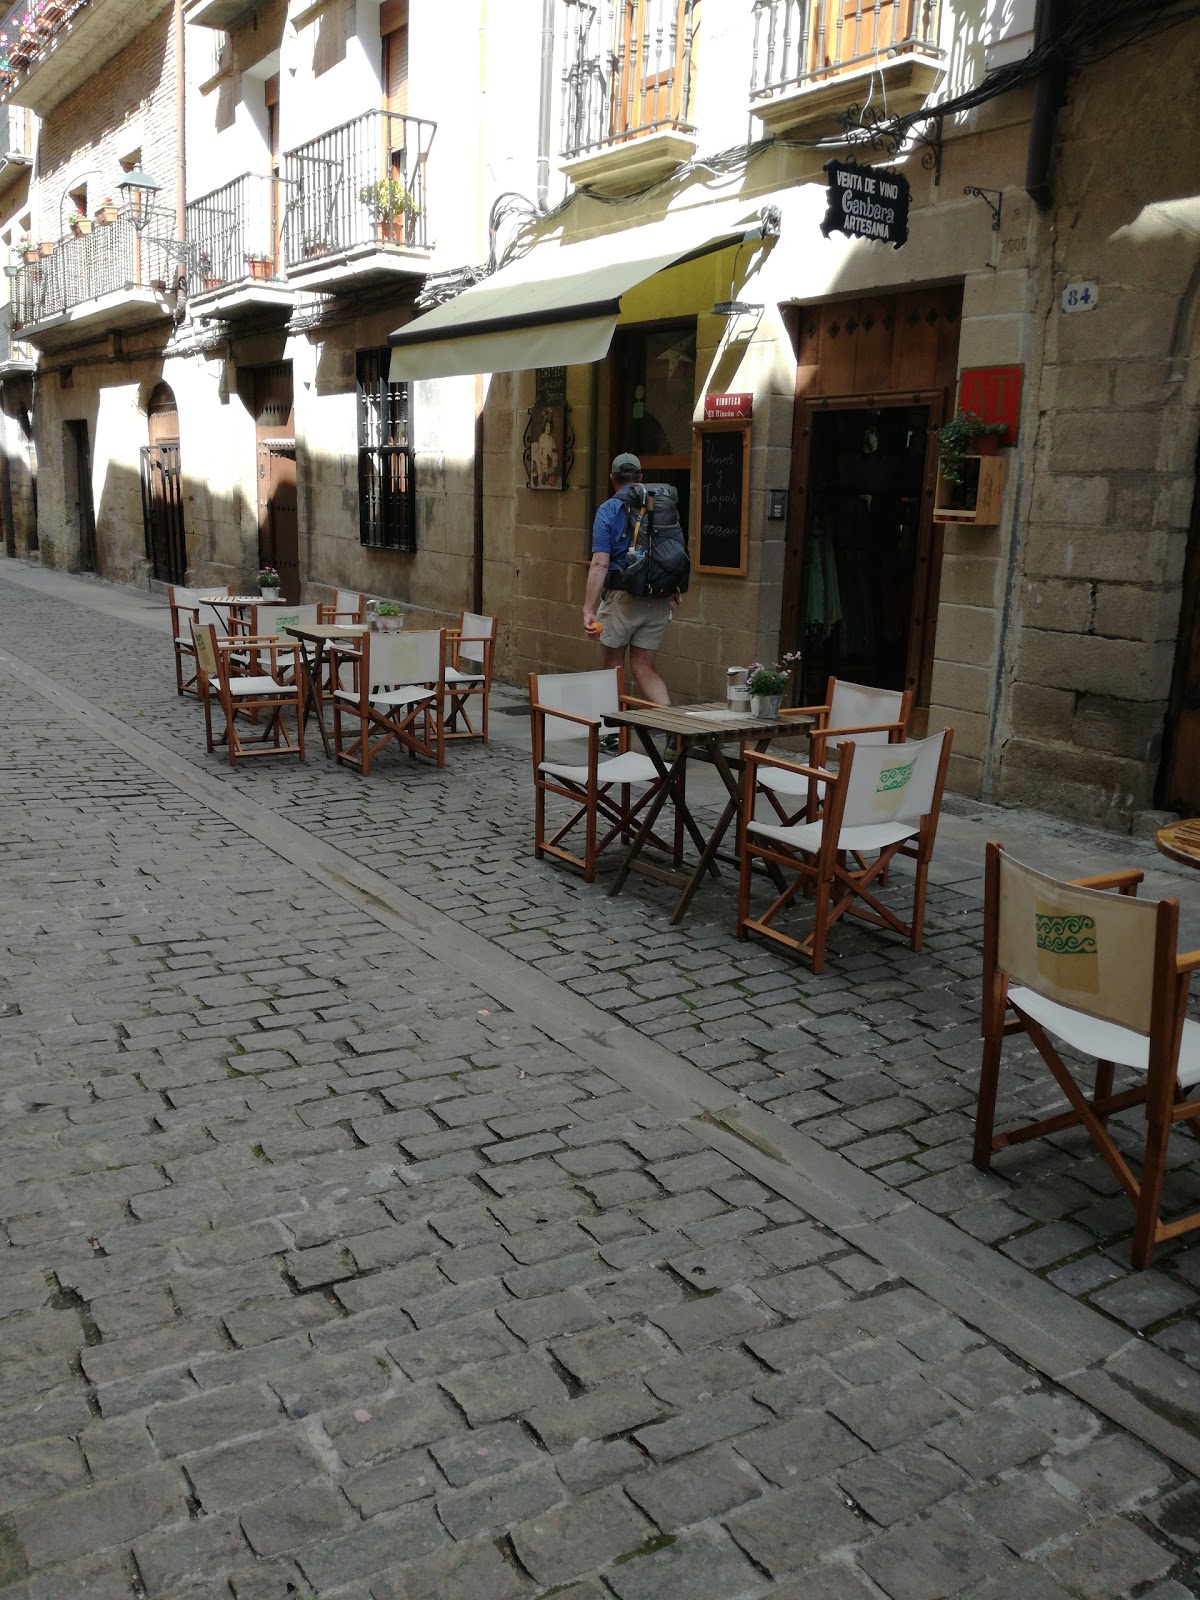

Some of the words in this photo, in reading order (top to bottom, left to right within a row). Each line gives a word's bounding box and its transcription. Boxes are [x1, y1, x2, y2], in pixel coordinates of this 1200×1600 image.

[836, 170, 862, 191] VENTA
[864, 177, 876, 194] DE
[879, 181, 899, 200] VINO
[841, 189, 894, 224] Ganbara
[843, 214, 889, 239] ARTESANIA
[715, 396, 741, 406] VINOTECA
[968, 374, 1015, 417] AT
[715, 409, 735, 418] Rincón
[704, 439, 736, 465] Vinos
[716, 468, 724, 489] y
[703, 483, 738, 513] Tapas
